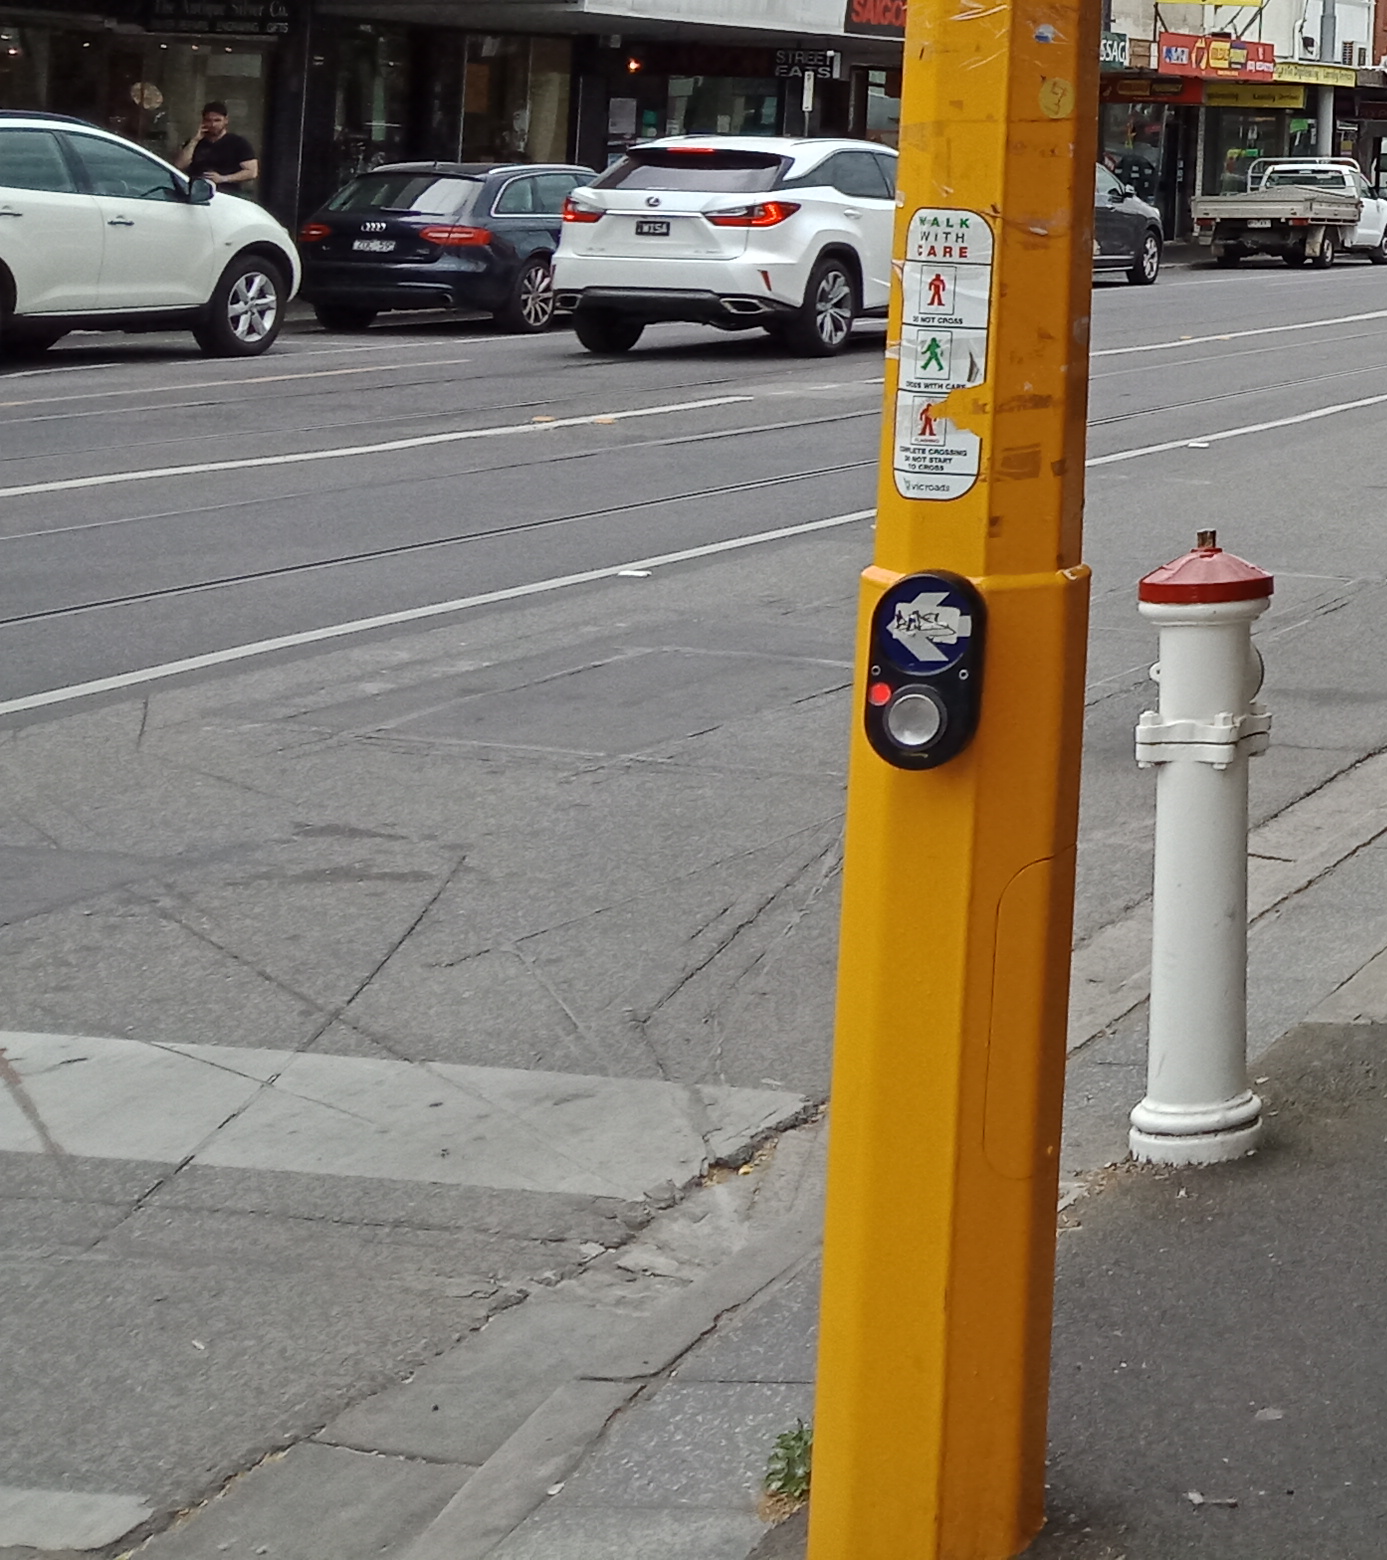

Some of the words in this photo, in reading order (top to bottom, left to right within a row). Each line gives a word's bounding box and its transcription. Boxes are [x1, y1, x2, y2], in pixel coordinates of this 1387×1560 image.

[919, 216, 970, 229] WALK
[921, 231, 965, 243] WITH
[917, 244, 968, 258] CARE
[937, 317, 963, 325] CROSS
